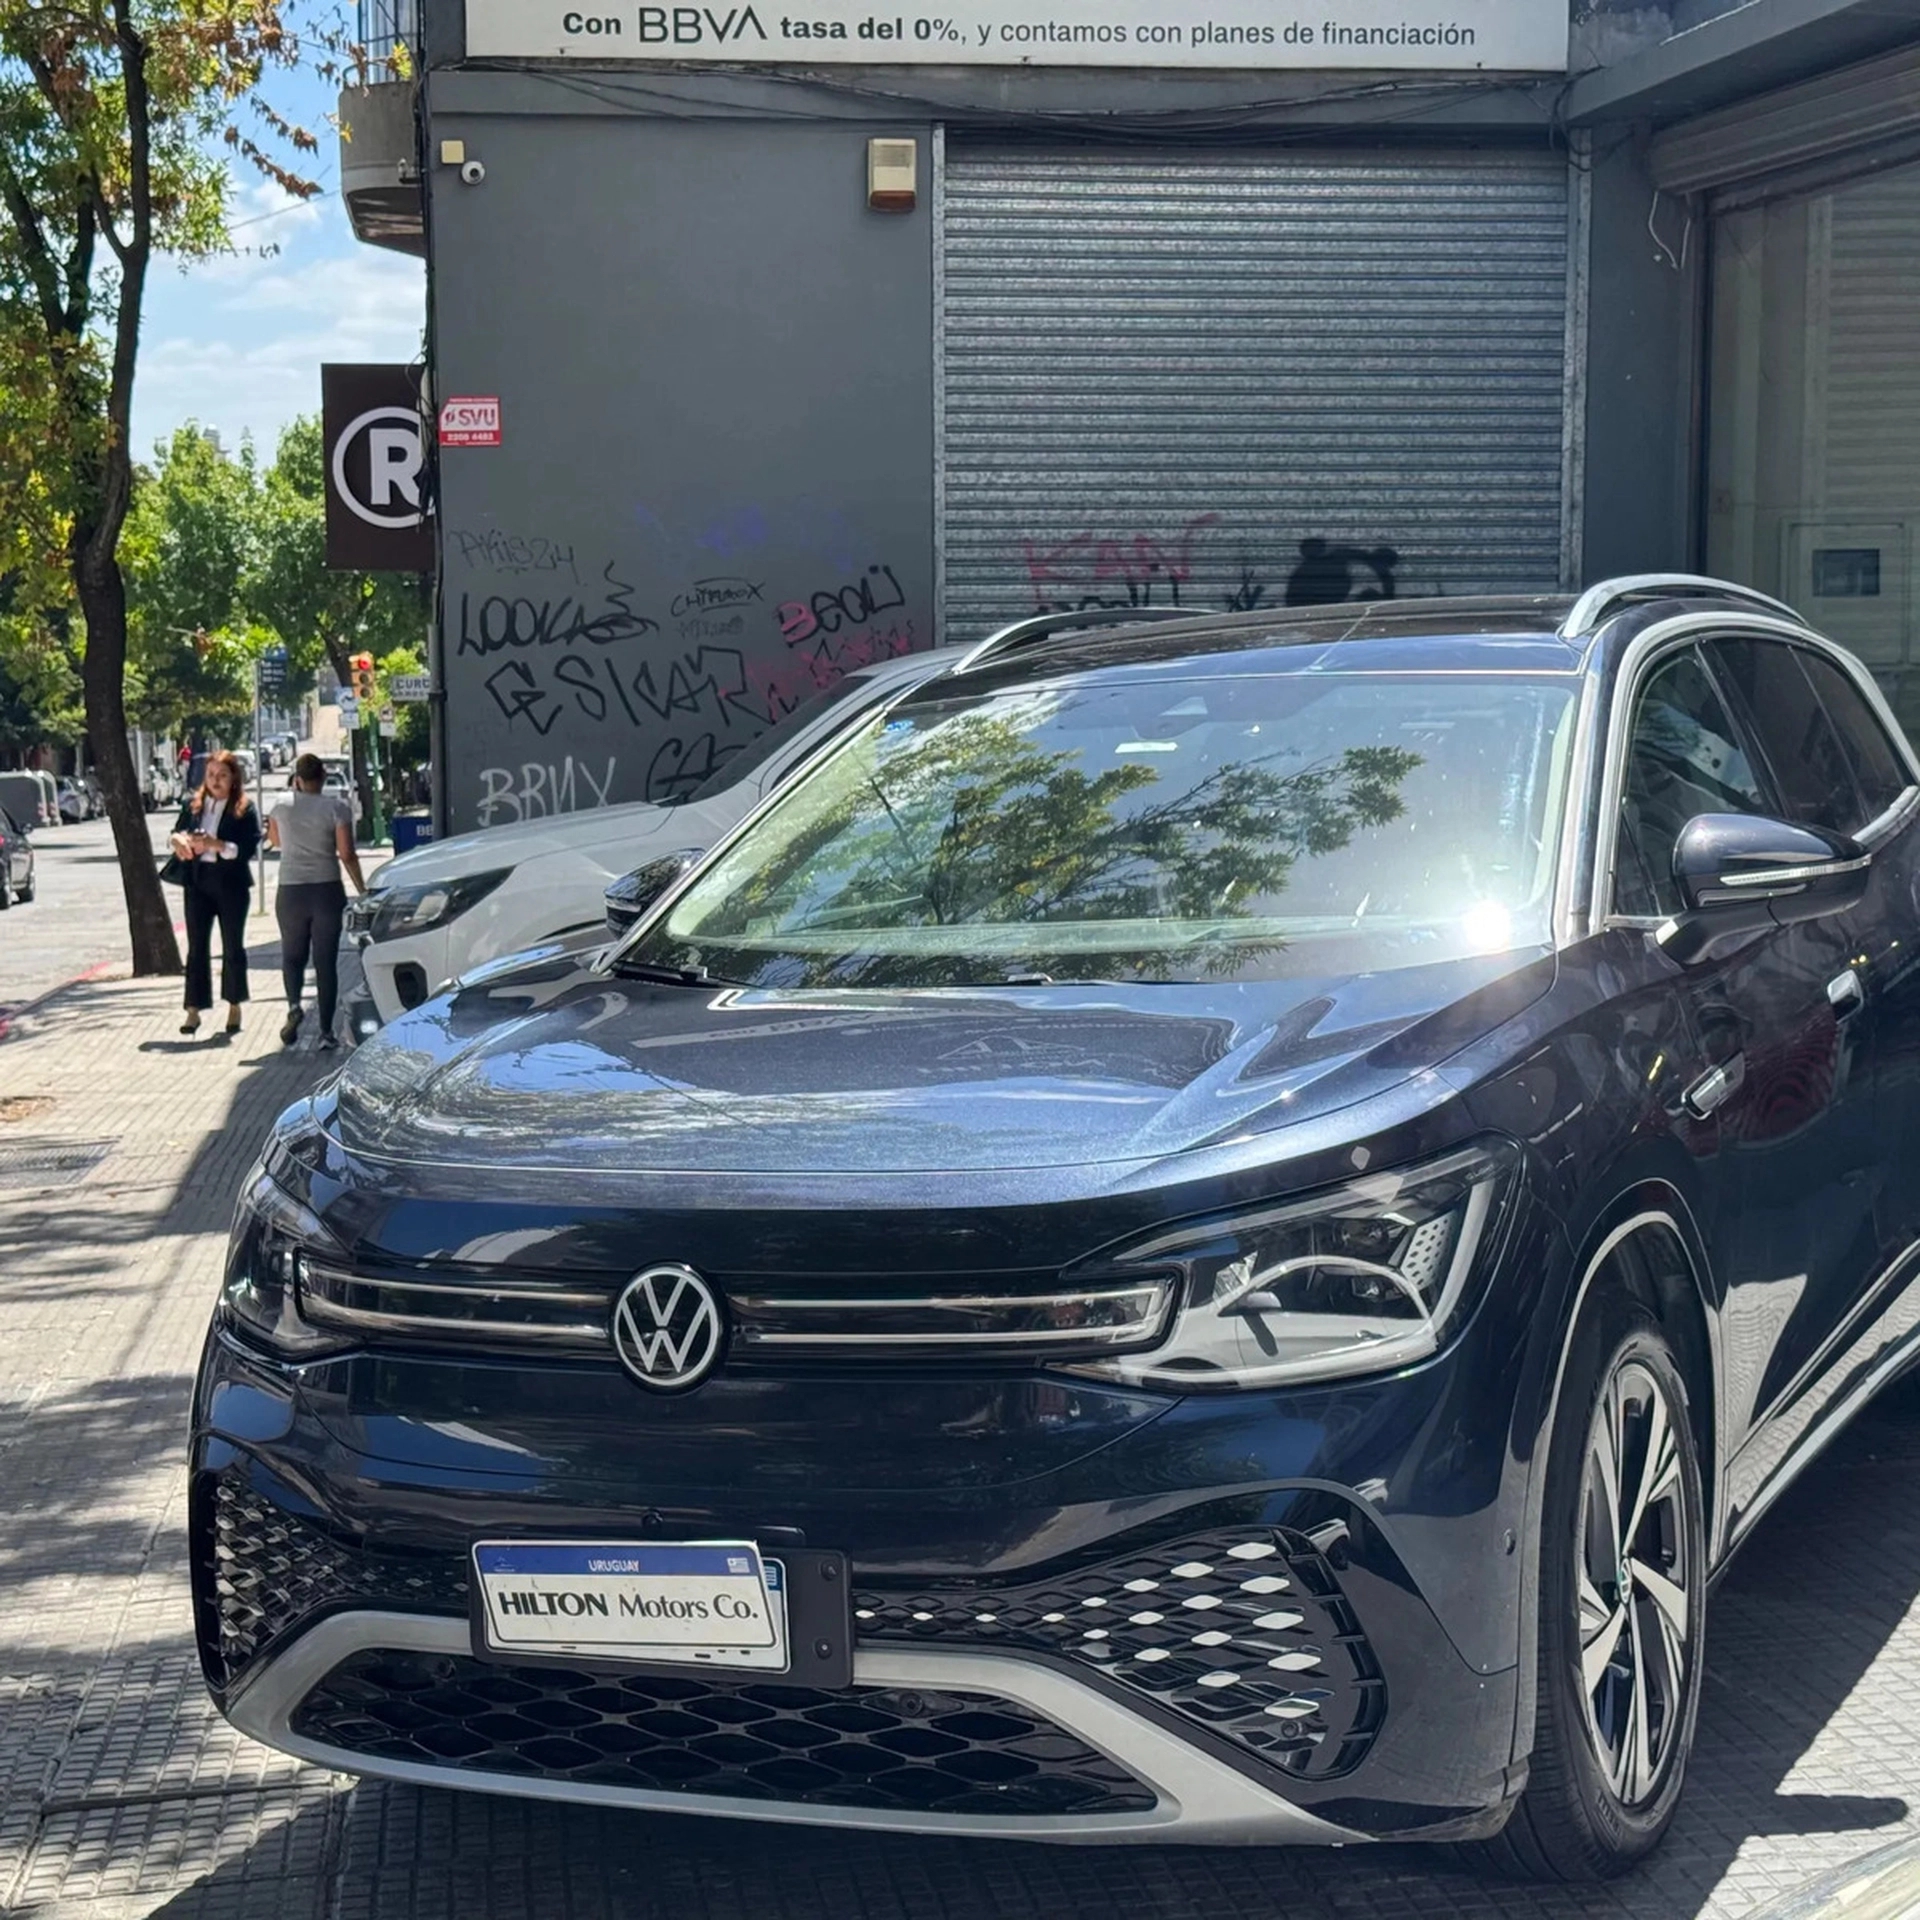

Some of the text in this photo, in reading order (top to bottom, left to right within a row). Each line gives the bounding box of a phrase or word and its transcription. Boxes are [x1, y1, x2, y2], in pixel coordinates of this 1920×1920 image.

[562, 5, 1476, 48] Con BBVA tasa del 0%, y contamos con planes de financiación
[458, 408, 496, 427] SVU
[587, 1558, 640, 1573] URUGUAY
[498, 1591, 759, 1619] HILTON Motors Co.
